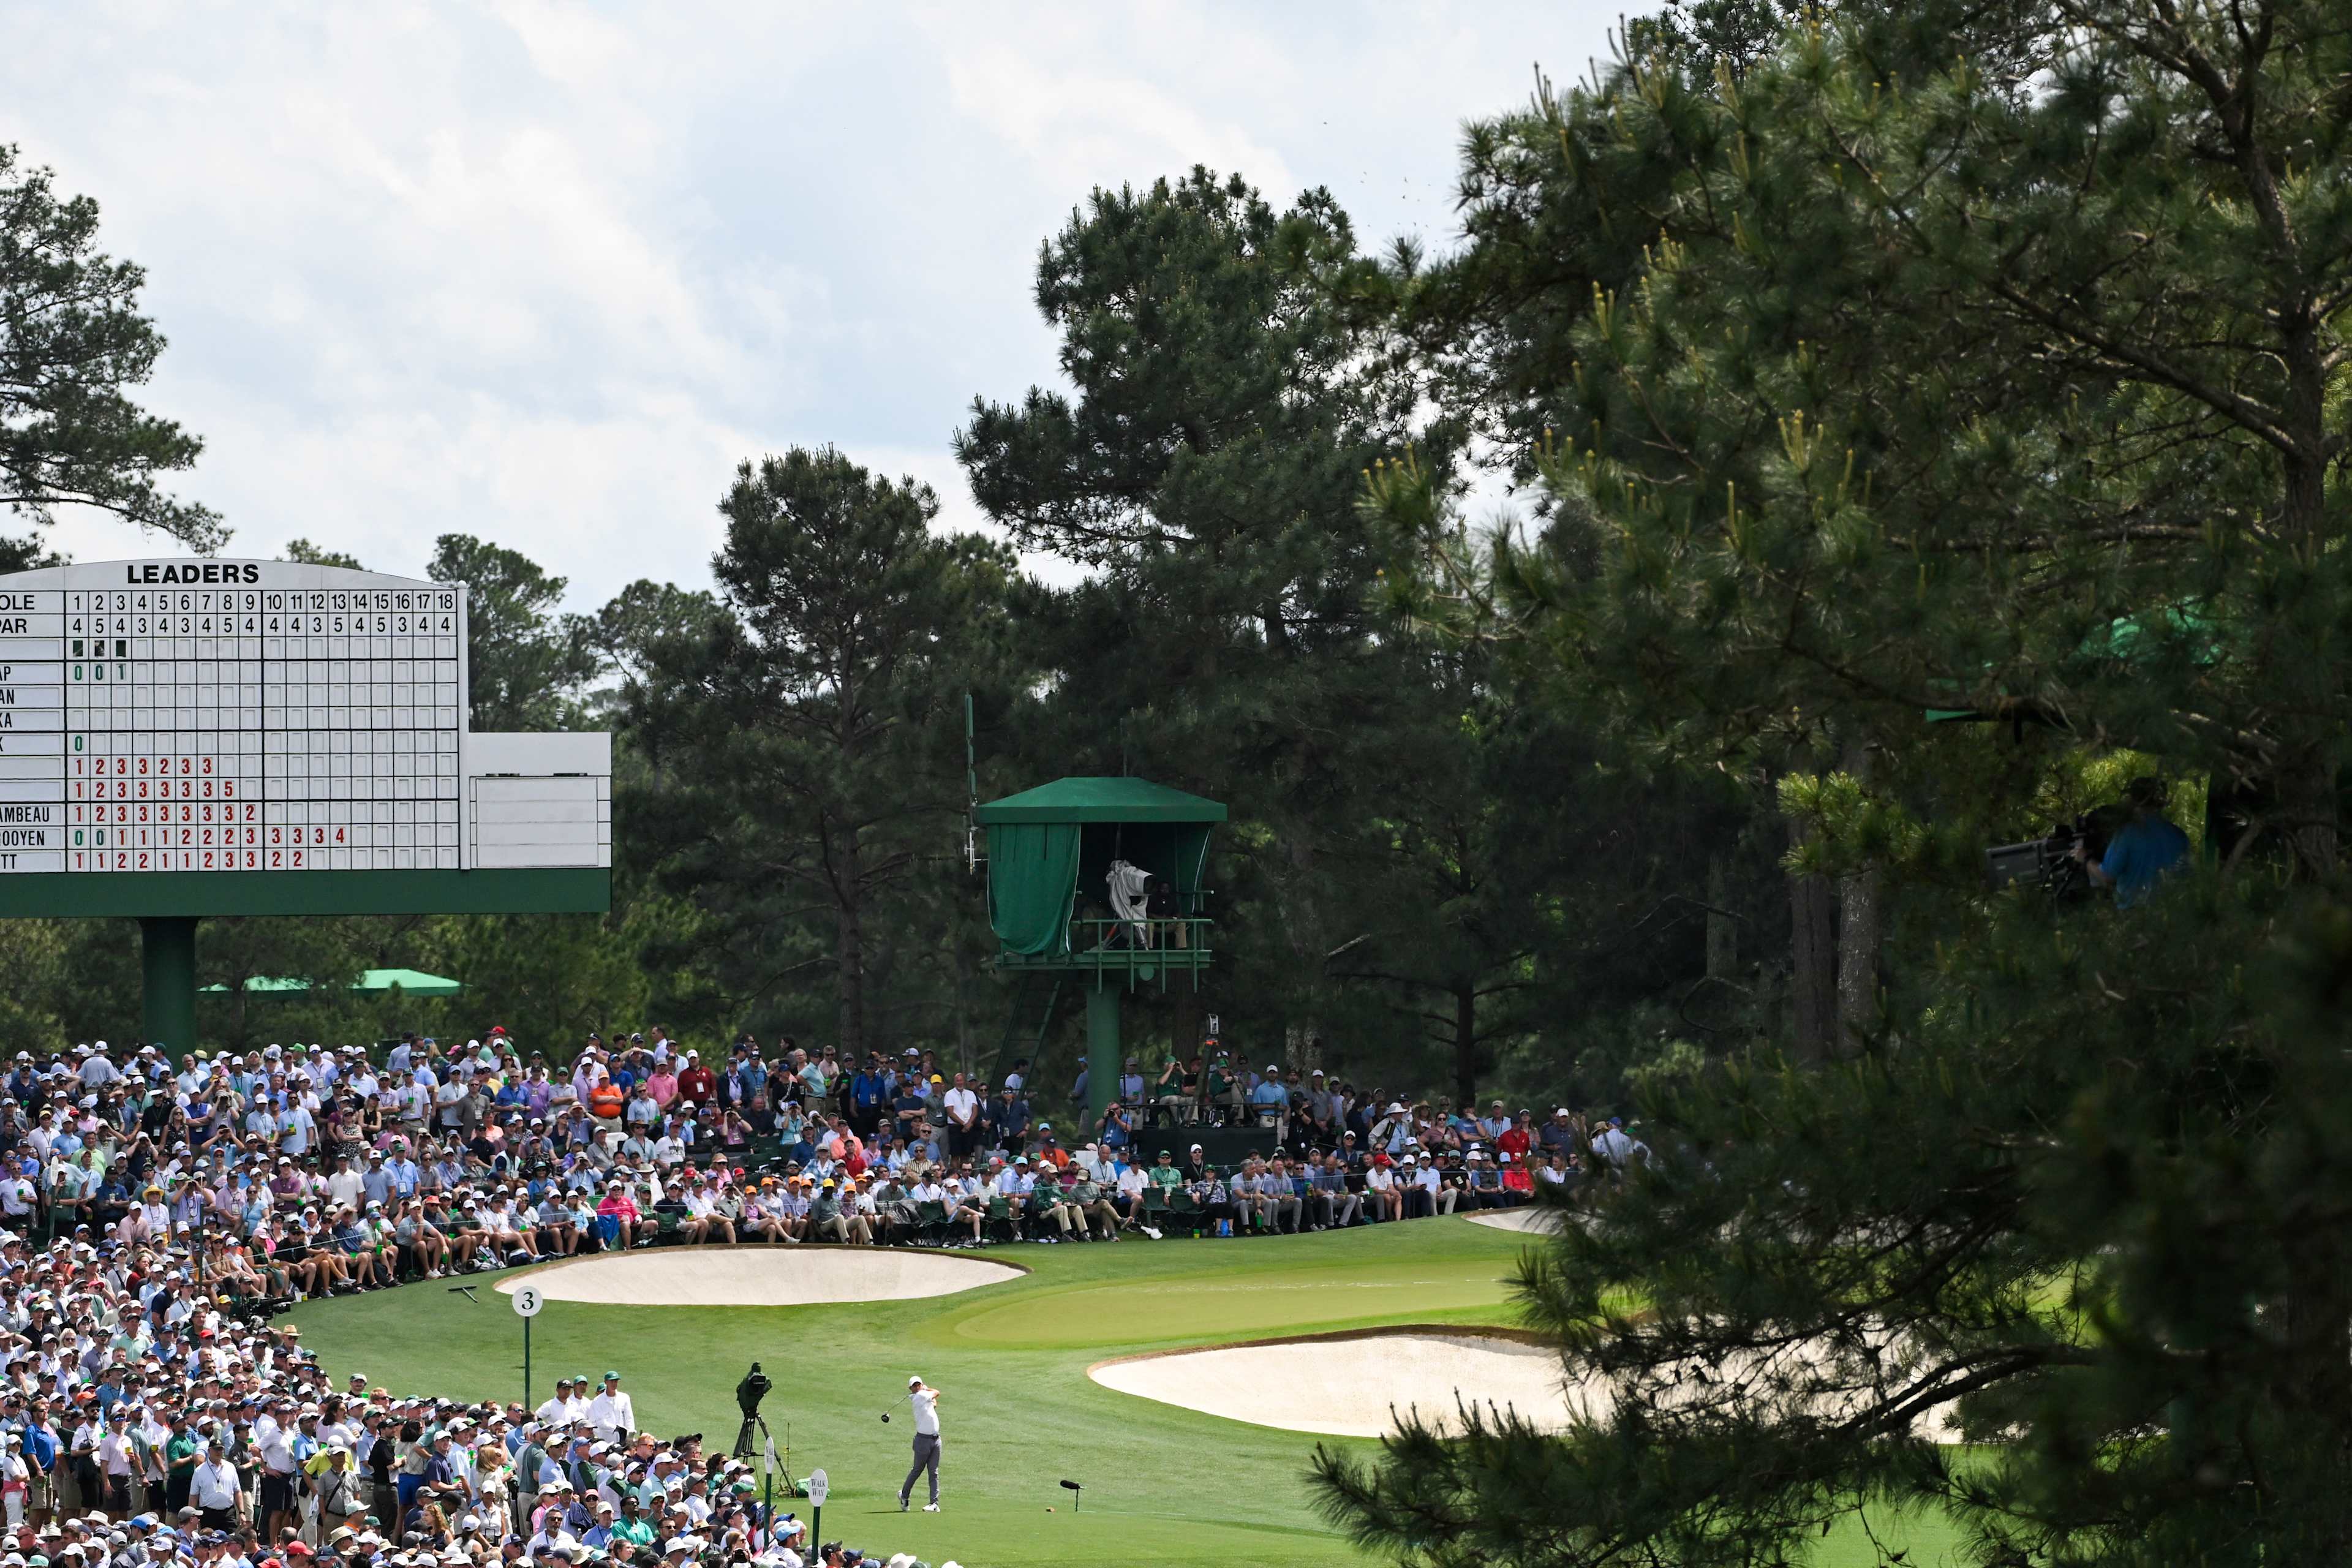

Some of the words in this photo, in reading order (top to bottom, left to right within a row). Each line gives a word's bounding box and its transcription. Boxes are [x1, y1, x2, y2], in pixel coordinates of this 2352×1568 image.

[128, 564, 258, 583] LEADERS
[75, 595, 79, 609] 1
[96, 595, 103, 609] 2
[117, 595, 125, 610] 3
[138, 595, 146, 609] 4
[160, 595, 167, 609] 5
[181, 595, 189, 610] 6
[203, 595, 210, 609] 7
[224, 595, 232, 609] 8
[246, 595, 254, 609] 9
[267, 595, 281, 609] 10
[291, 595, 301, 609] 11
[311, 594, 324, 609] 12
[331, 594, 346, 609] 13
[353, 594, 368, 609] 14
[374, 594, 388, 609] 15
[395, 594, 410, 609] 16
[417, 594, 430, 608] 17
[438, 594, 453, 609] 18
[0, 619, 26, 633] AR
[73, 619, 81, 633] 4
[96, 619, 104, 633] 5
[116, 619, 125, 633] 4
[138, 618, 146, 633] 3
[159, 618, 168, 632] 4
[181, 618, 189, 633] 3
[202, 618, 211, 632] 4
[224, 618, 232, 633] 5
[246, 618, 254, 632] 4
[270, 617, 278, 632] 4
[292, 617, 300, 632] 4
[314, 617, 322, 632] 3
[334, 617, 342, 632] 5
[356, 617, 364, 631] 4
[377, 617, 385, 632] 5
[399, 617, 406, 632] 3
[420, 617, 428, 631] 4
[441, 617, 450, 631] 4
[74, 665, 82, 681] 0
[95, 665, 102, 680] 0
[118, 665, 124, 680] 1
[74, 736, 83, 752] 0
[76, 760, 81, 774] 1
[96, 759, 104, 775] 2
[117, 759, 126, 774] 3
[139, 758, 147, 774] 3
[160, 759, 168, 775] 2
[181, 758, 189, 775] 3
[203, 758, 211, 775] 3
[76, 782, 81, 797] 1
[97, 783, 104, 797] 2
[118, 782, 125, 798] 3
[139, 782, 147, 797] 3
[161, 781, 169, 797] 3
[181, 782, 190, 798] 3
[203, 782, 211, 798] 3
[225, 781, 233, 796] 5
[76, 807, 81, 821] 1
[97, 807, 104, 821] 2
[117, 806, 126, 821] 3
[140, 806, 147, 822] 3
[161, 806, 168, 822] 3
[183, 806, 190, 821] 3
[203, 805, 211, 822] 3
[225, 806, 233, 821] 3
[246, 805, 254, 821] 2
[0, 831, 44, 846] OOYEN
[75, 830, 83, 846] 0
[97, 831, 104, 845] 0
[119, 830, 124, 845] 1
[141, 830, 146, 845] 1
[162, 830, 167, 845] 1
[183, 829, 190, 844] 2
[203, 829, 211, 845] 2
[225, 829, 233, 845] 2
[246, 829, 254, 843] 3
[273, 828, 280, 843] 3
[293, 828, 301, 843] 3
[316, 828, 323, 843] 3
[336, 828, 343, 843] 4
[76, 853, 81, 868] 1
[98, 853, 104, 868] 1
[118, 853, 126, 868] 2
[139, 852, 147, 869] 2
[162, 853, 167, 867] 1
[184, 853, 189, 867] 1
[205, 852, 212, 869] 2
[225, 852, 233, 867] 3
[247, 852, 255, 867] 3
[273, 852, 280, 867] 2
[293, 852, 301, 867] 2
[521, 1291, 534, 1310] 3
[811, 1479, 826, 1487] WALK
[812, 1488, 824, 1496] WAY
